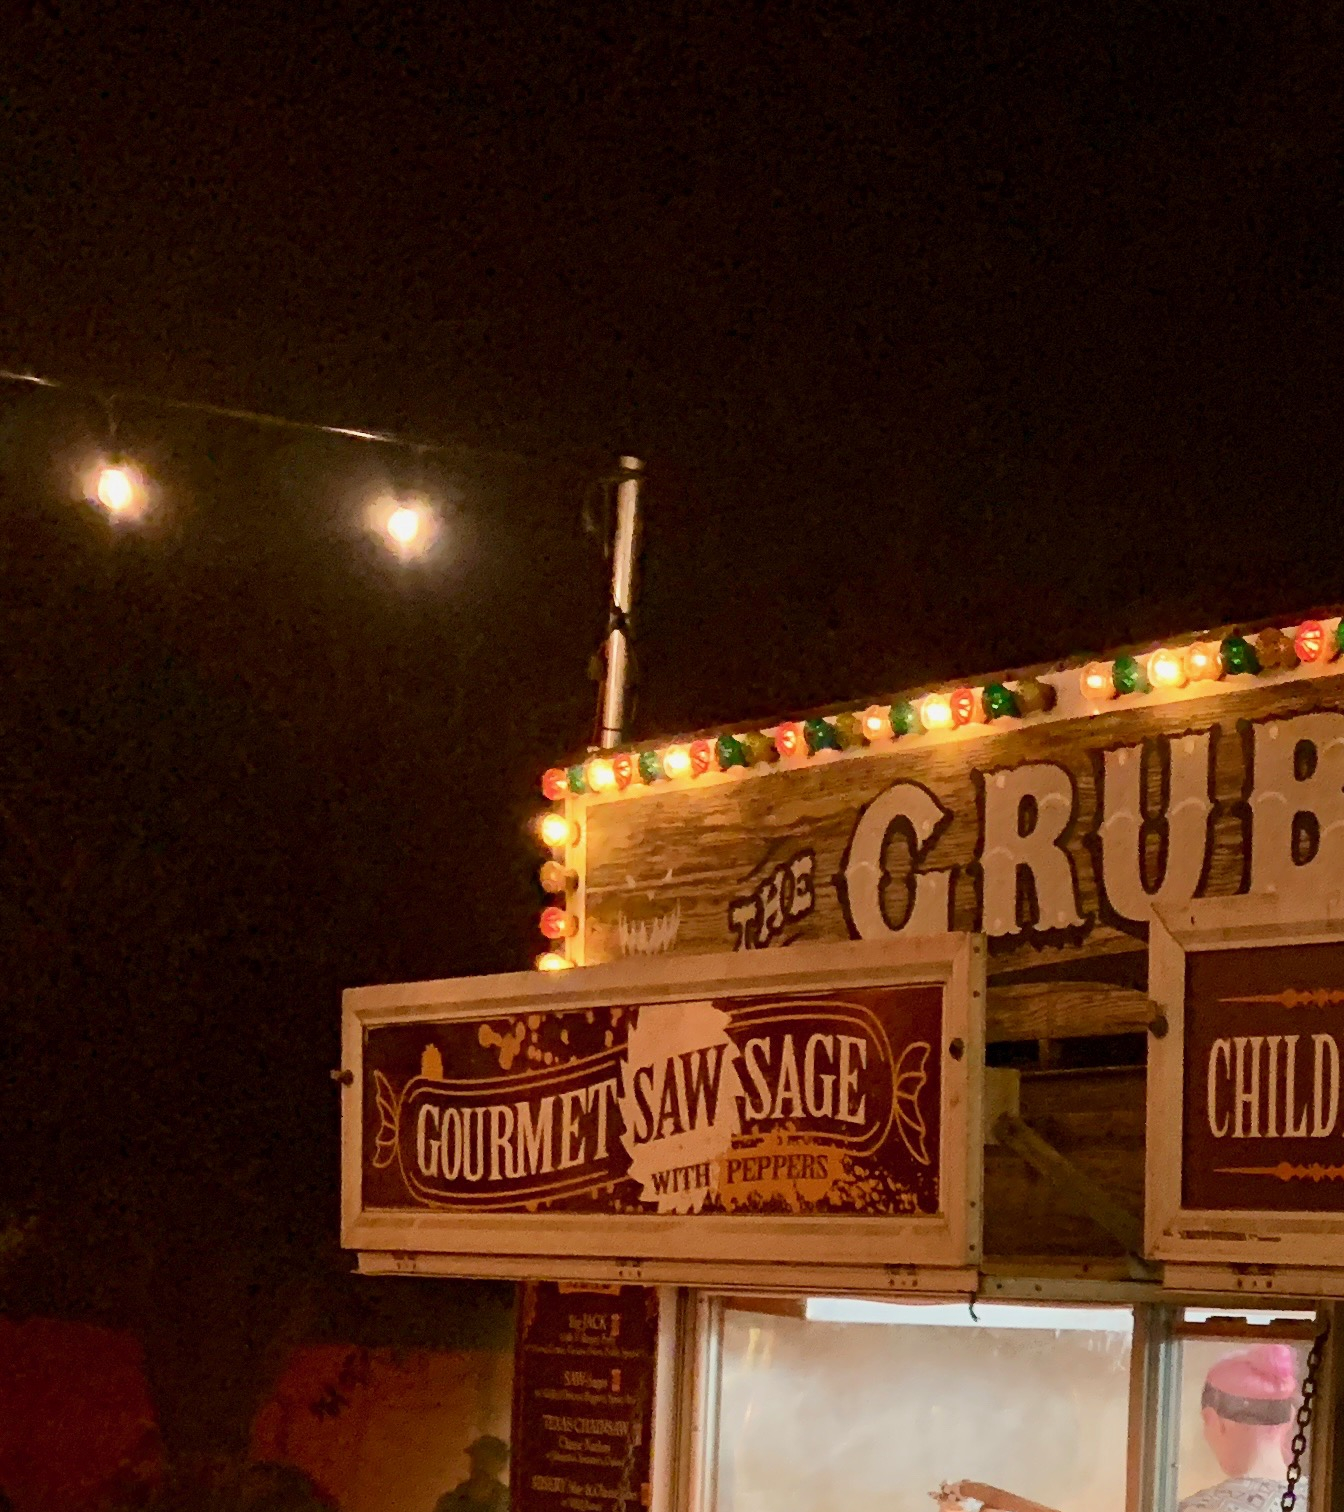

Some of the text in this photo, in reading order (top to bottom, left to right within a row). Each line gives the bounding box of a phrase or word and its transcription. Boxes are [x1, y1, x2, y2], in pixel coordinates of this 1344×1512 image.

[730, 850, 814, 951] THE
[417, 1075, 623, 1183] GOURMET
[652, 1153, 829, 1195] WITH PEPPERS
